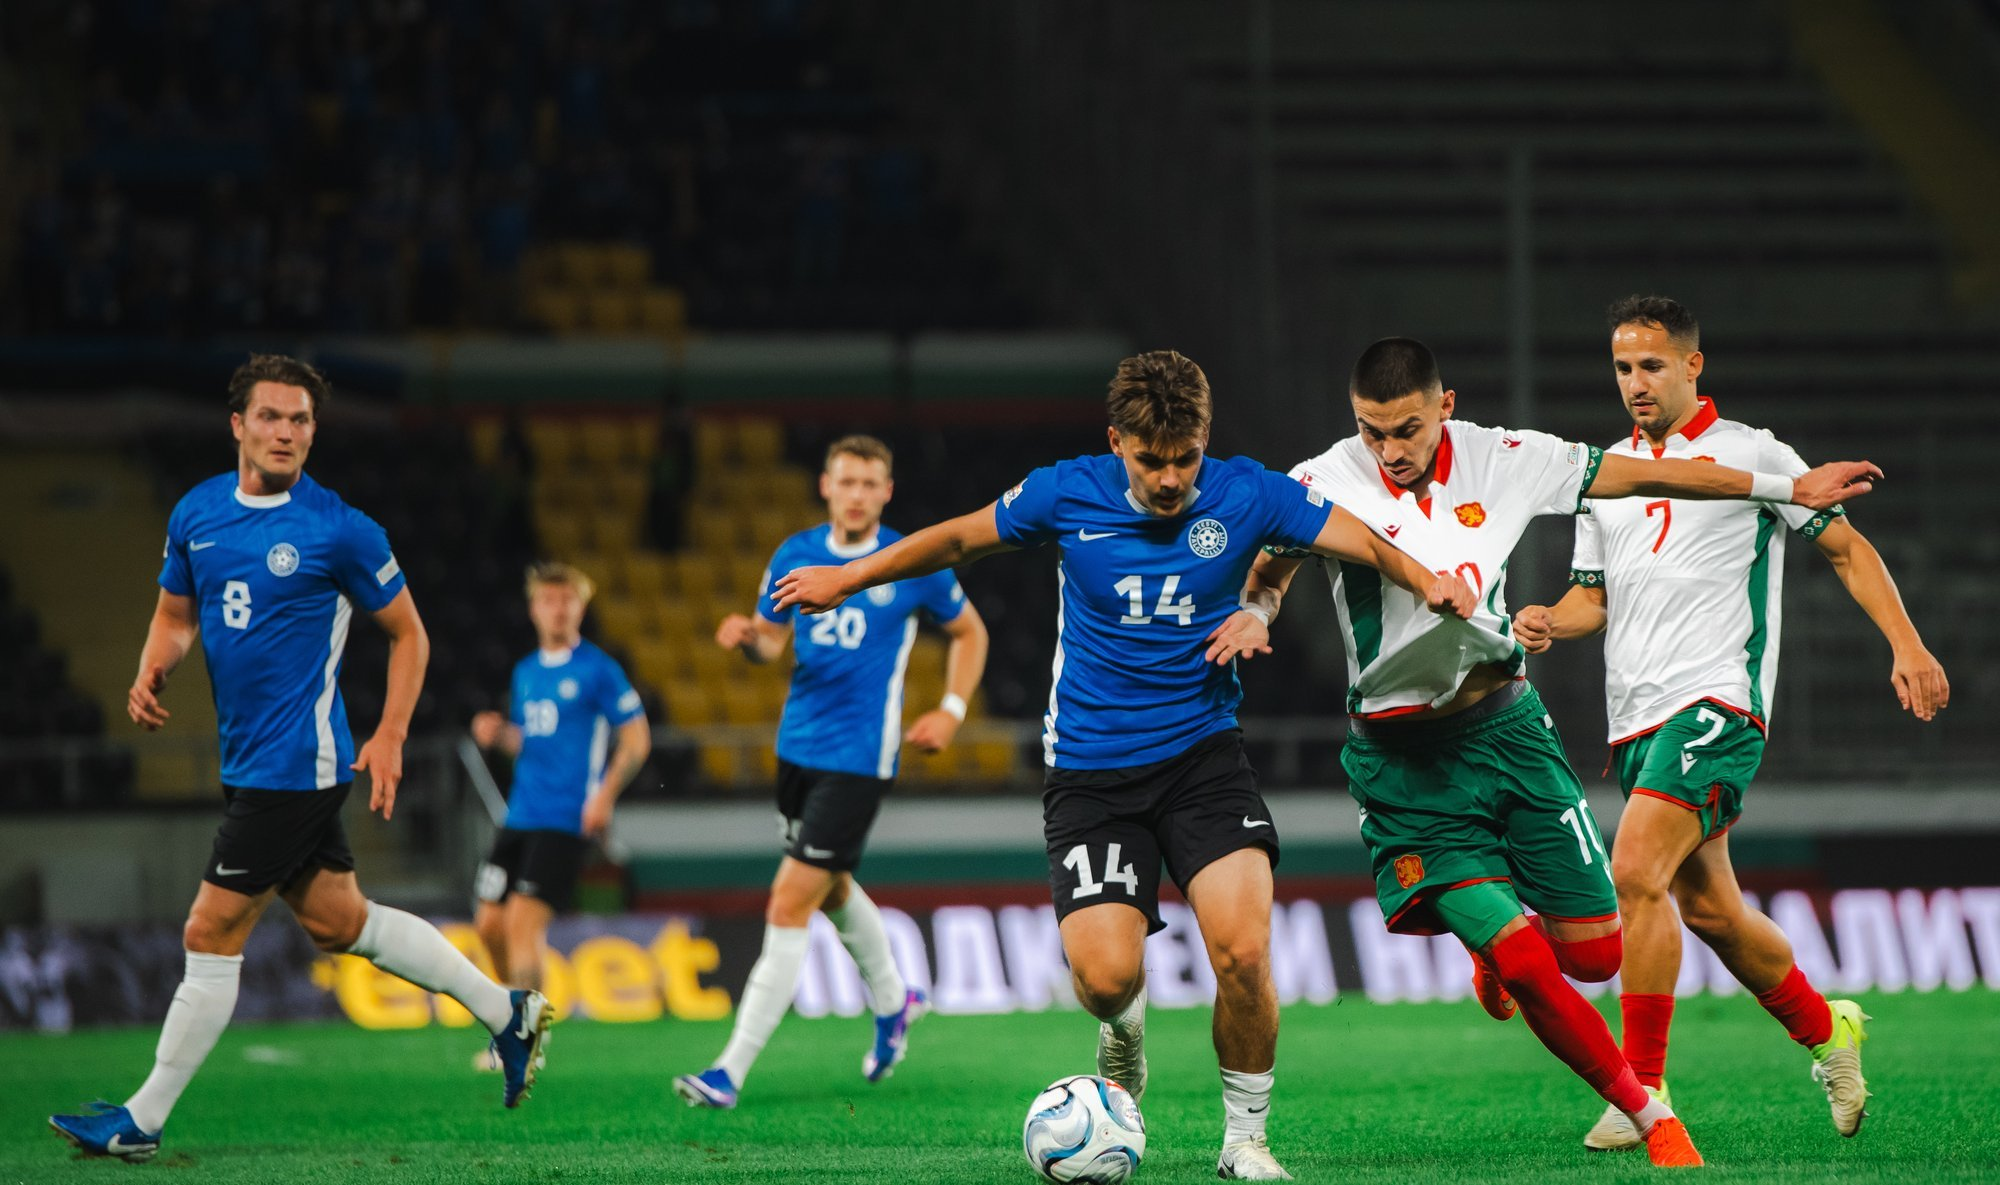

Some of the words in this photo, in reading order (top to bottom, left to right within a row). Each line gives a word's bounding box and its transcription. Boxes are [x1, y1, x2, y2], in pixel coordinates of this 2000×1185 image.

[1196, 521, 1219, 530] EESTI
[1646, 499, 1672, 554] 7
[1113, 575, 1196, 626] 14
[1435, 562, 1483, 601] 0
[222, 581, 252, 630] 8
[810, 606, 868, 650] 20
[1683, 706, 1726, 749] 7
[1062, 843, 1138, 899] 14
